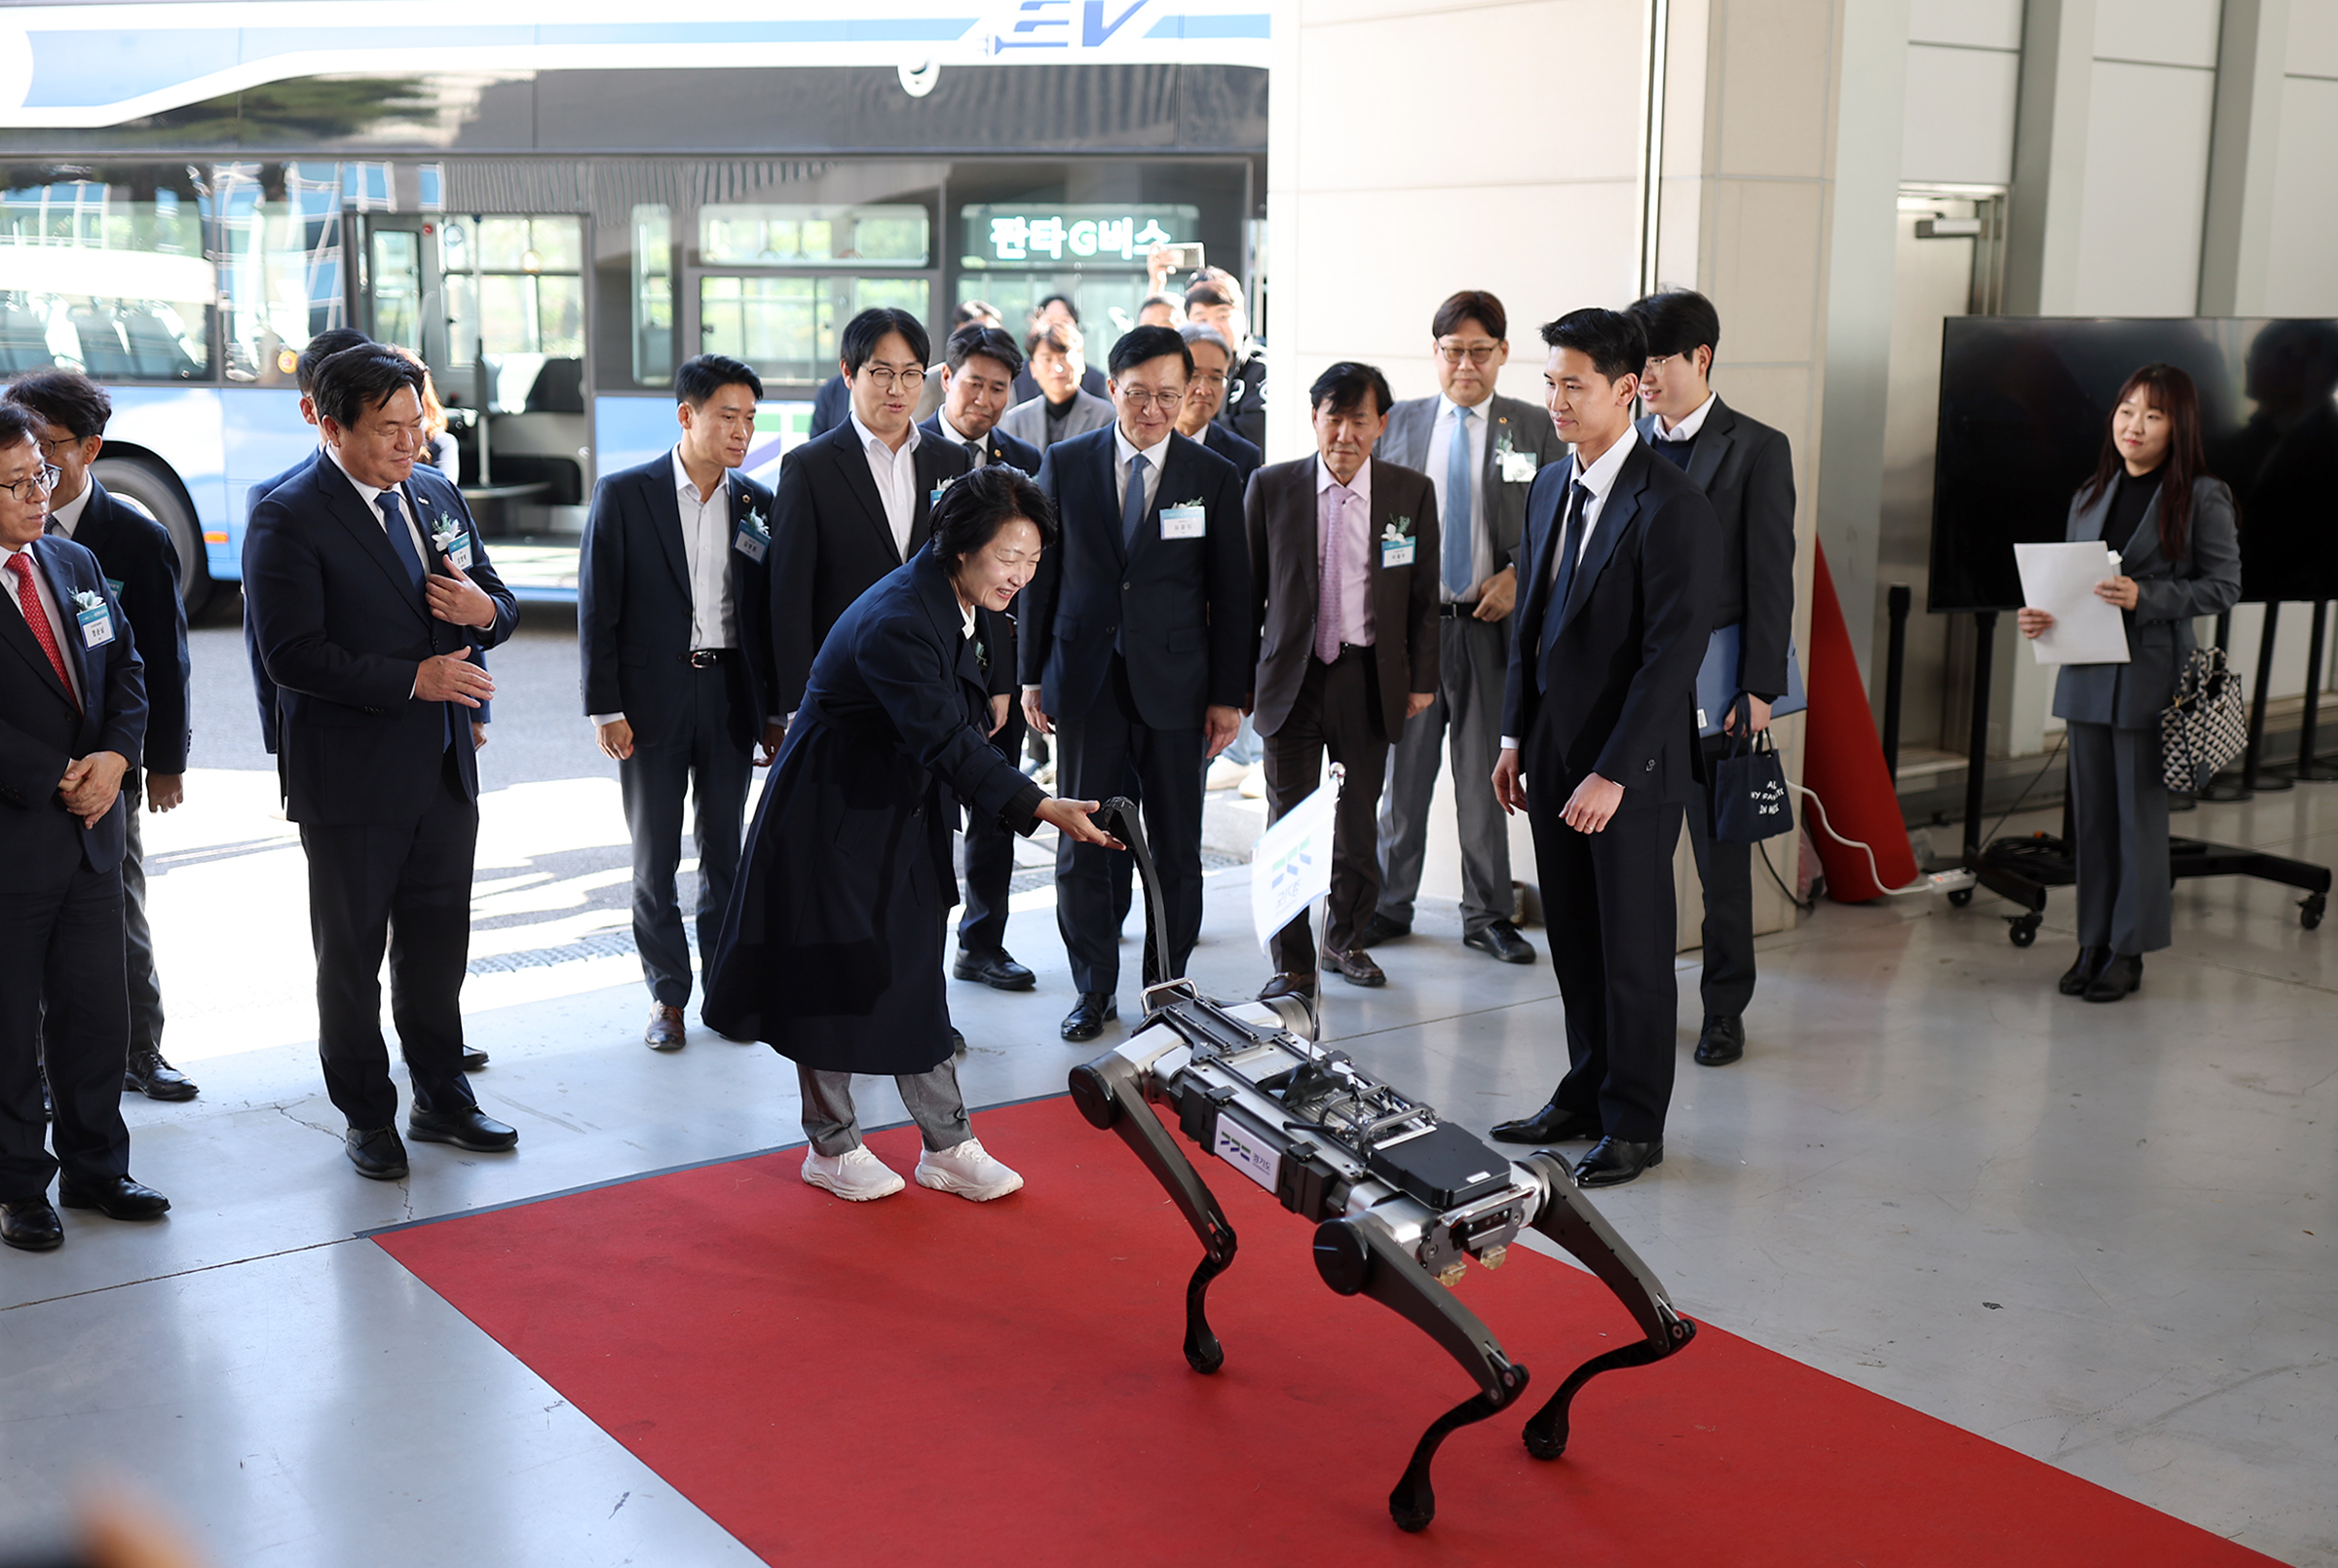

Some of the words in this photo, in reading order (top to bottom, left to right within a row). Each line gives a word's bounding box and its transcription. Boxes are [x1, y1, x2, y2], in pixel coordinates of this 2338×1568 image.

[995, 0, 1149, 55] EV
[990, 216, 1171, 260] 판타G버스
[1253, 1153, 1271, 1172] 경기도
